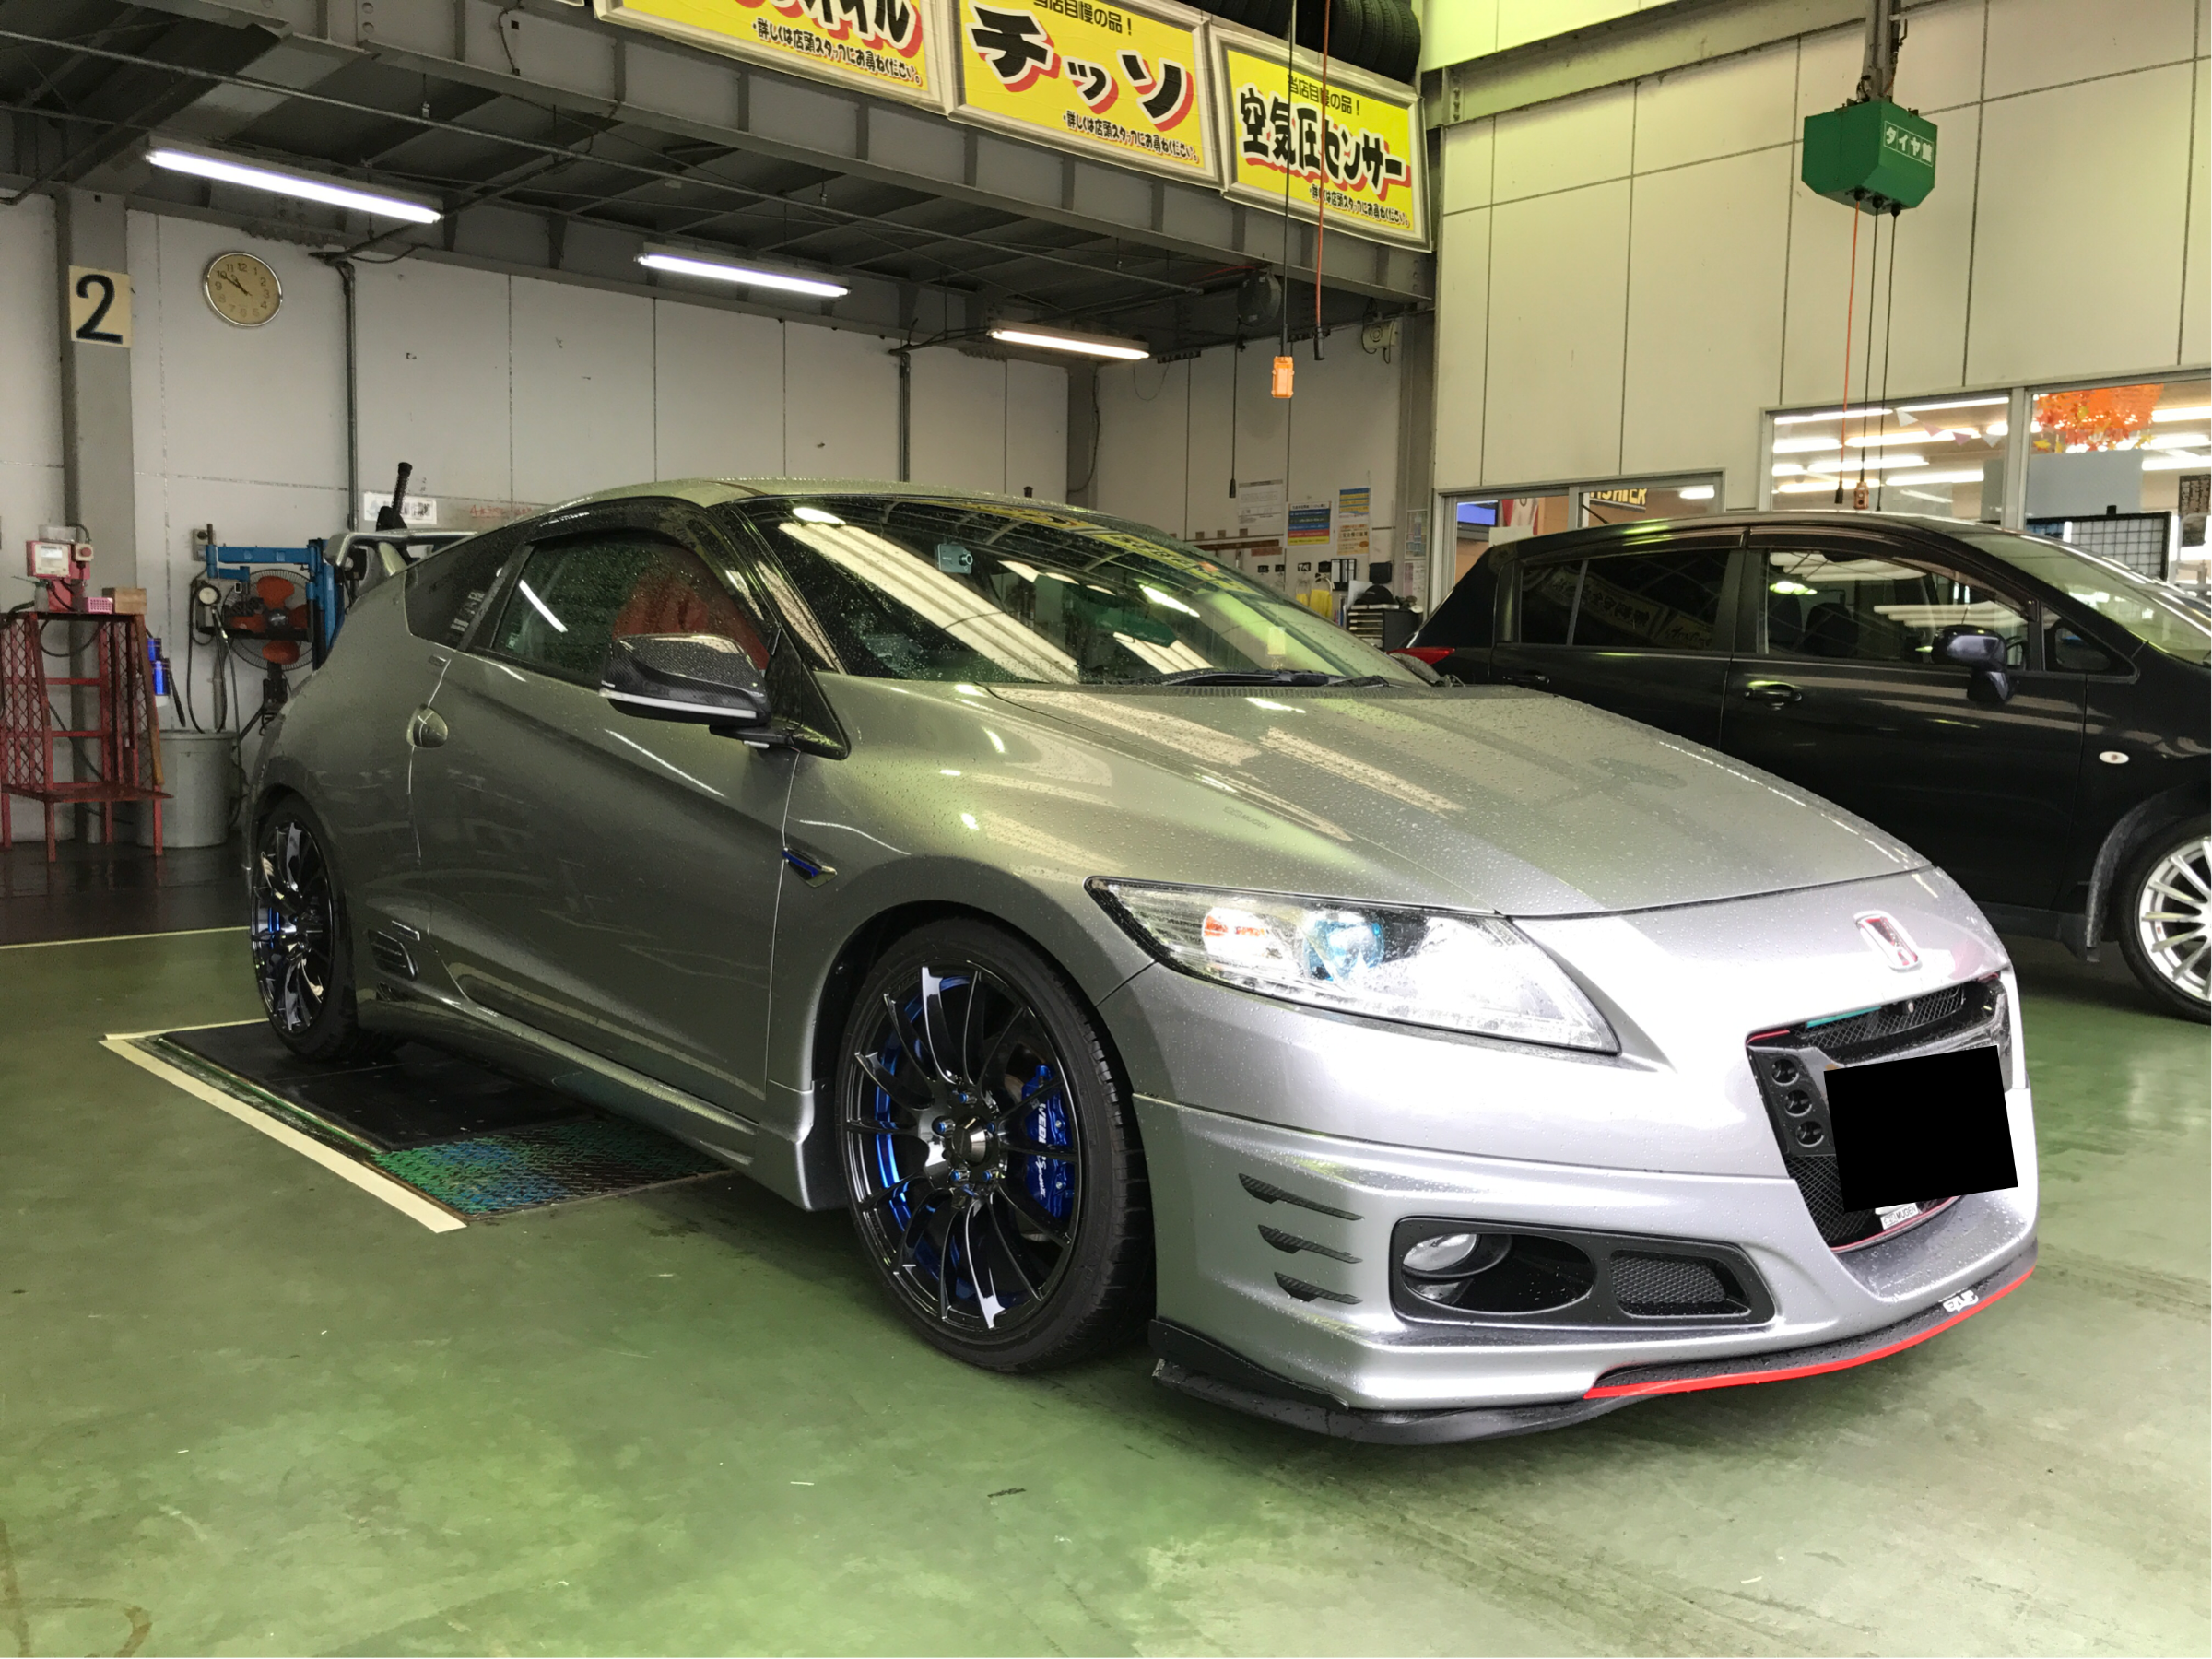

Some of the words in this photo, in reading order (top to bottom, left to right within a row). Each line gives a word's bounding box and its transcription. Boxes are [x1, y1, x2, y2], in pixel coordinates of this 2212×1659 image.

[1241, 87, 1403, 191] 空気圧センサー
[226, 264, 234, 272] 11
[238, 262, 248, 272] 12
[76, 274, 123, 345] 2
[1895, 1205, 1917, 1220] MUGEN
